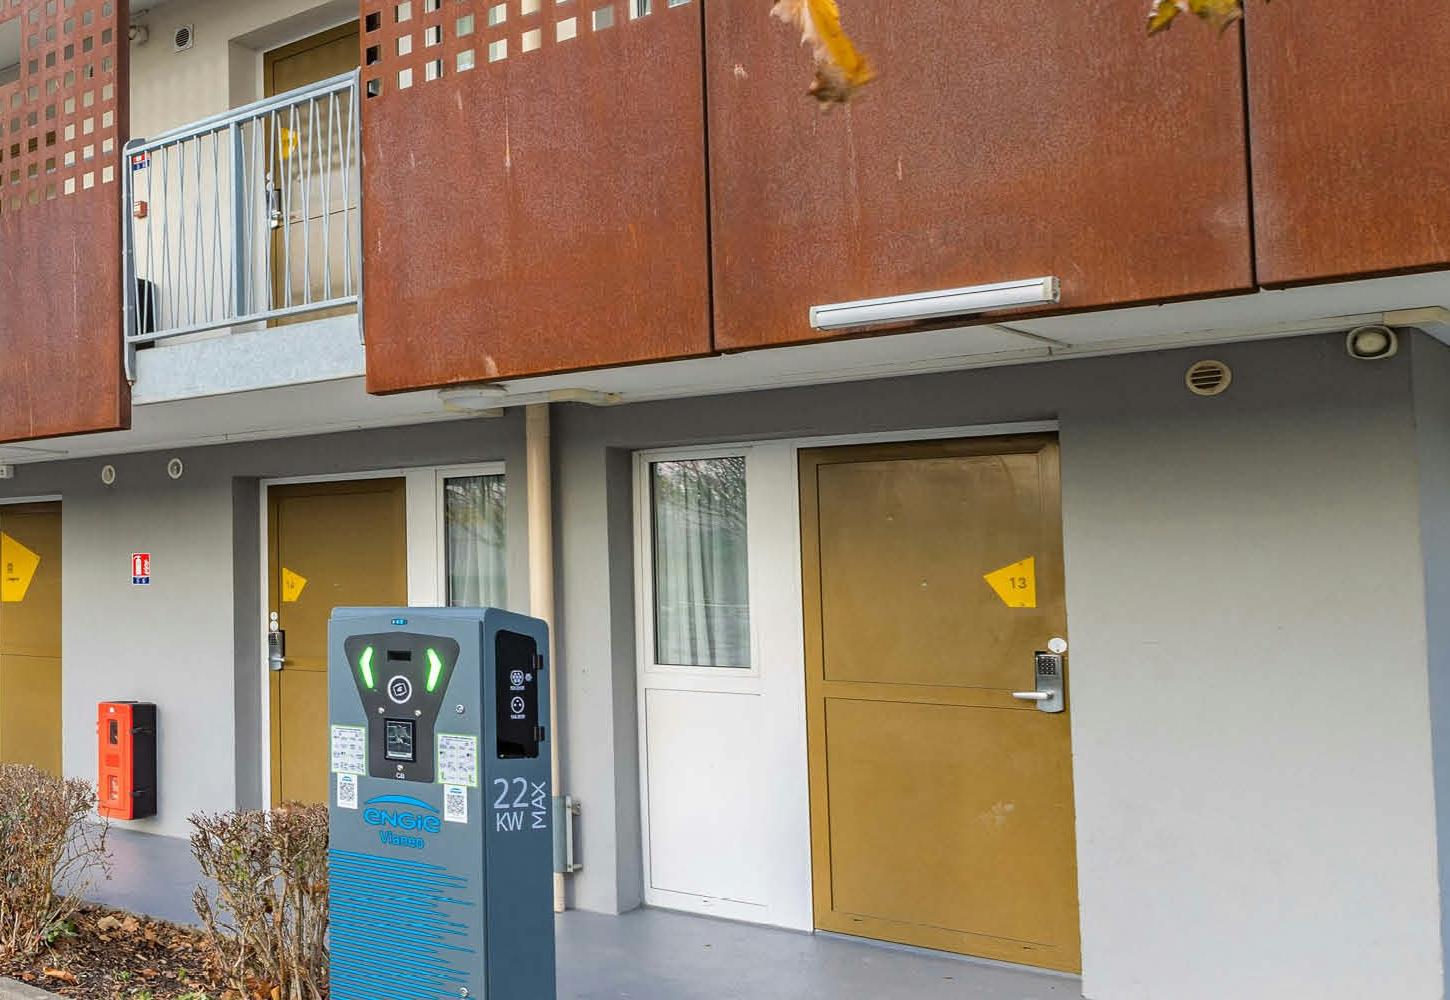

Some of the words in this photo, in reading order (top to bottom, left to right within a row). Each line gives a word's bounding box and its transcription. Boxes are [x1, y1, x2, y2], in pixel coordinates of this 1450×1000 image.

[1009, 577, 1028, 590] 13
[493, 777, 529, 809] 22
[531, 781, 547, 829] MAX
[496, 811, 524, 832] KW
[379, 830, 425, 849] Vianeo
